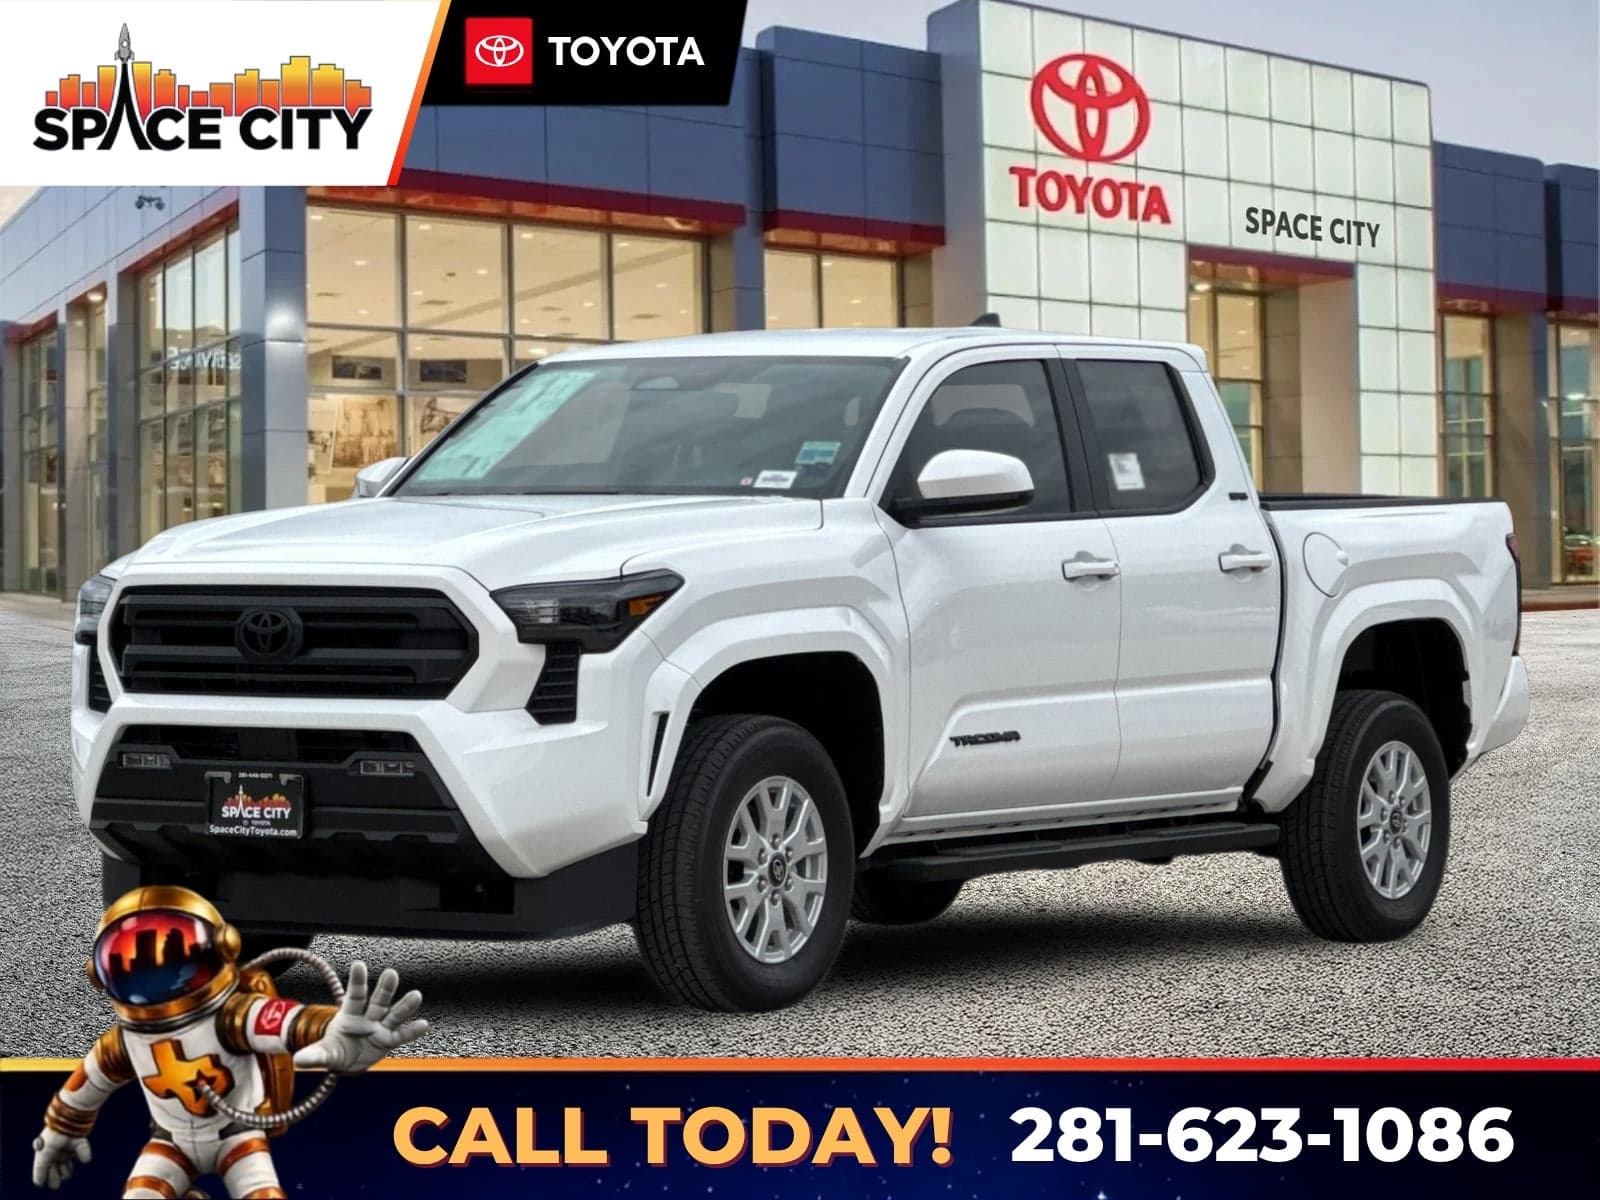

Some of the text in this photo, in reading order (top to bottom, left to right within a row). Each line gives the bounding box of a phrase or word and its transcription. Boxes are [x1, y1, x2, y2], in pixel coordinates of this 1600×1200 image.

[1009, 166, 1171, 224] TOYOTA
[1245, 207, 1380, 247] SPACE CITY
[949, 731, 1021, 747] TACOMA
[221, 805, 292, 819] SPACE CITY
[209, 824, 298, 837] SpaceCityToyota.com
